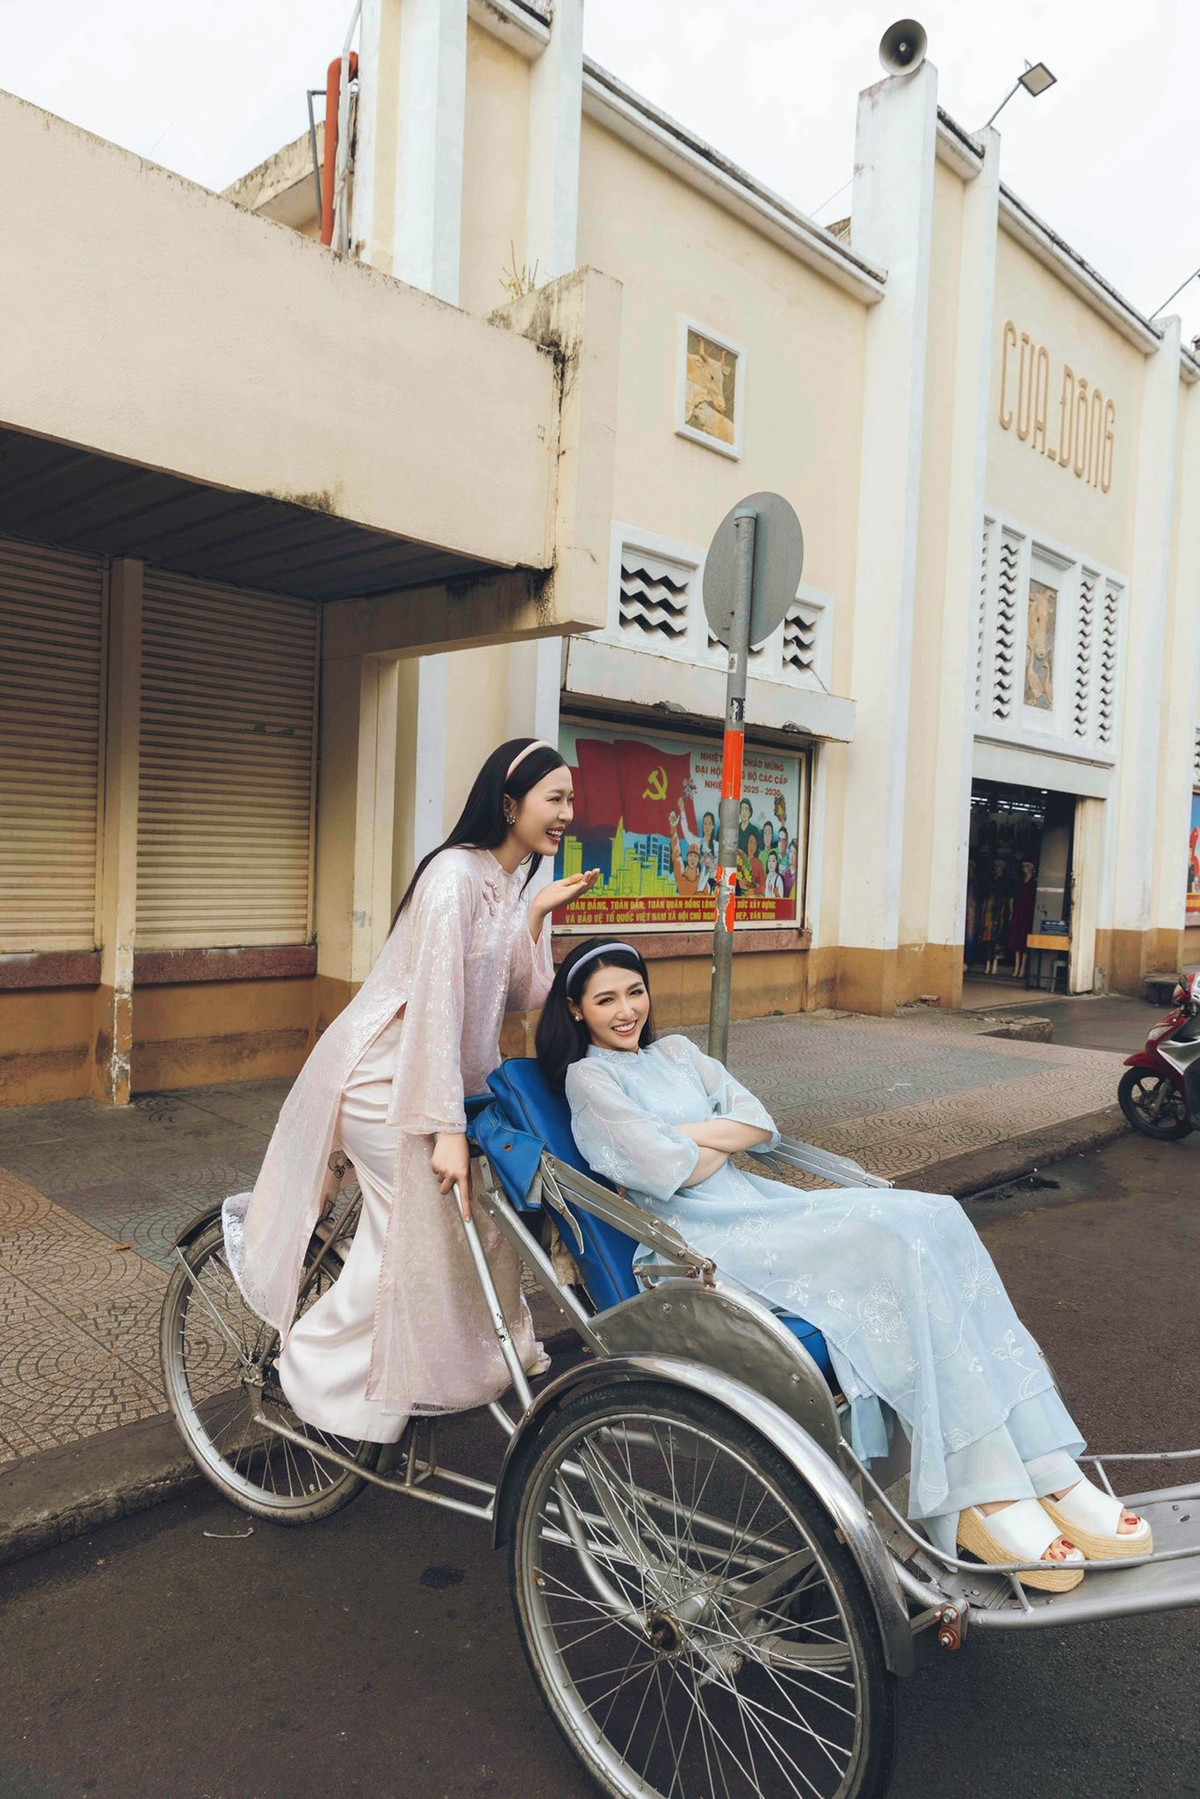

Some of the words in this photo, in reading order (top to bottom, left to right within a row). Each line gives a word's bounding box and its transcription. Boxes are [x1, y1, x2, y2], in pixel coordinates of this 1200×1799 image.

[695, 765, 708, 776] ĐẠI
[748, 772, 757, 783] BỘ
[759, 772, 773, 783] CÁC
[775, 774, 788, 785] CẤP
[743, 785, 759, 794] 2025
[765, 787, 781, 797] 2030
[611, 899, 628, 909] TOÀN
[648, 898, 665, 909] TOÀN
[616, 911, 634, 923] QUỐC
[651, 912, 667, 921] NAM
